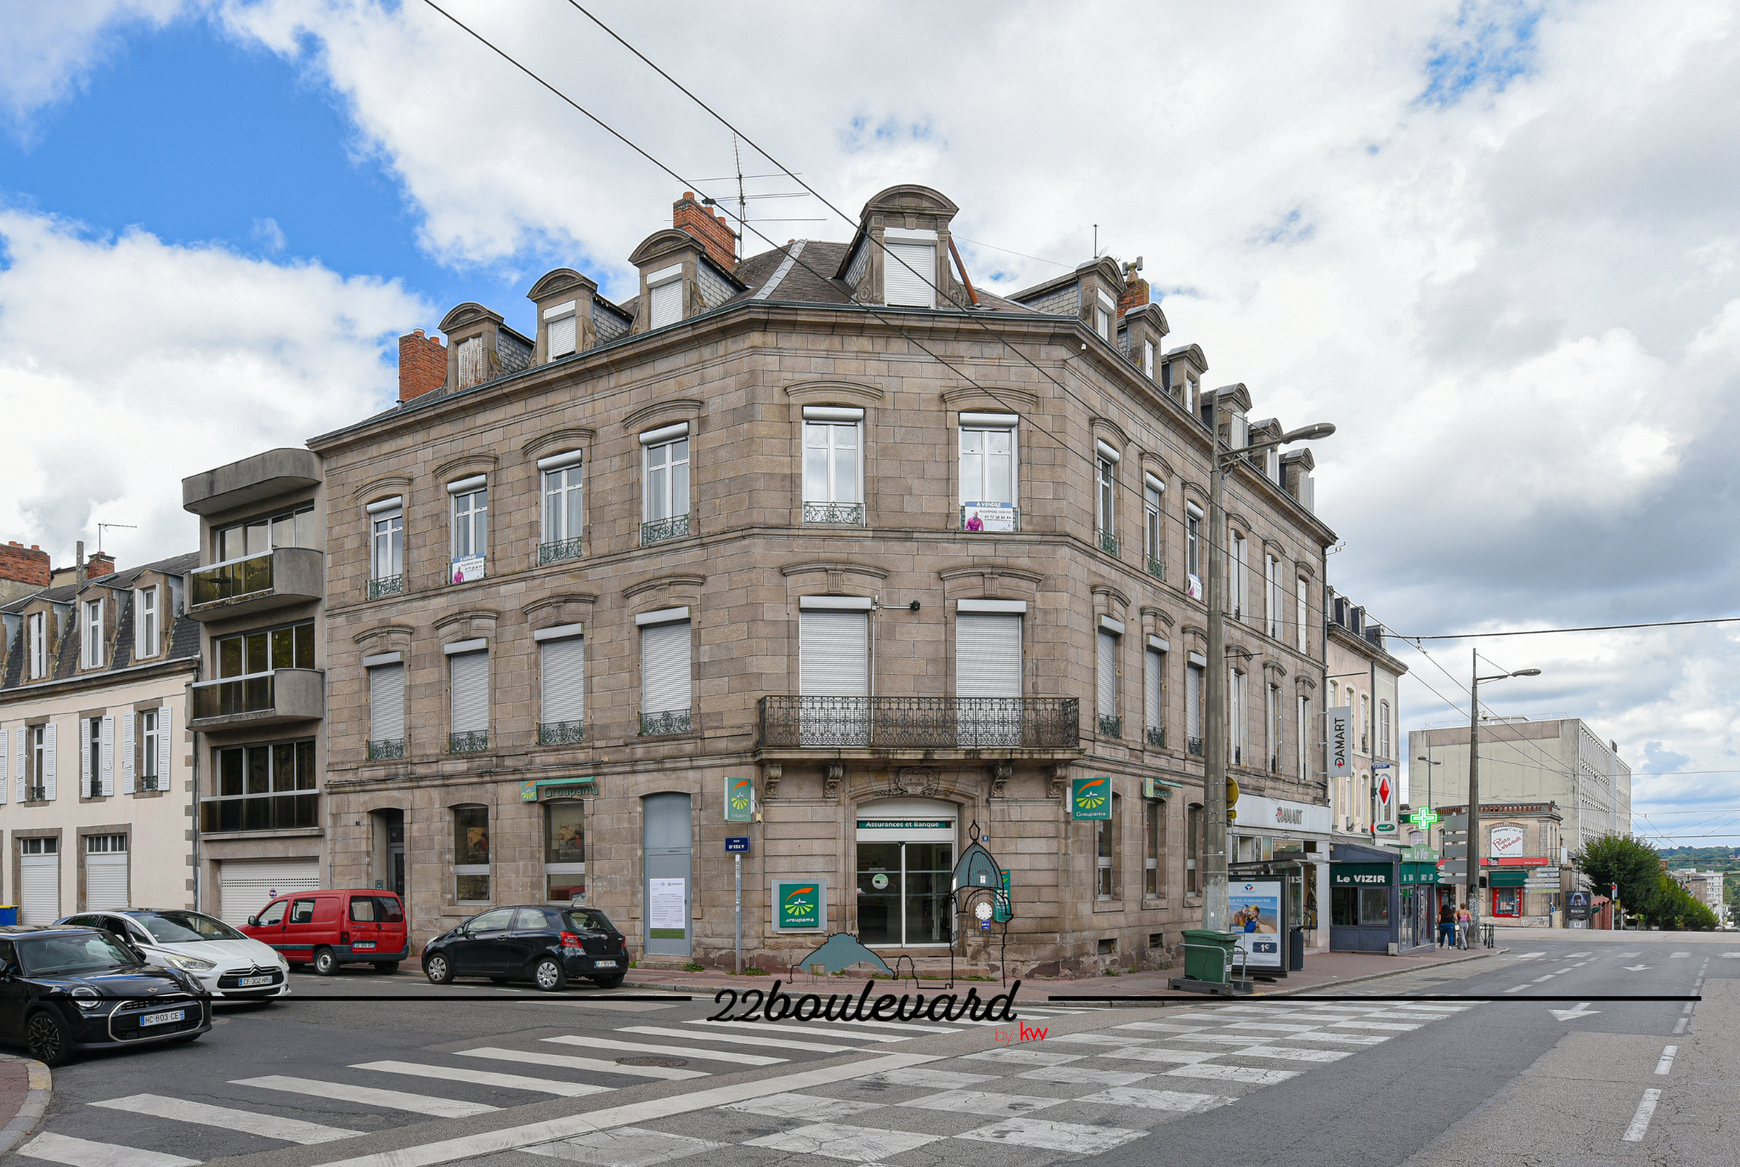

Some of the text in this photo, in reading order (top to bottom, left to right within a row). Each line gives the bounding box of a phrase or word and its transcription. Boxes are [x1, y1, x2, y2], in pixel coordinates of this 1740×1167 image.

[1334, 717, 1345, 769] DAMART
[543, 787, 599, 798] Groupama
[914, 821, 940, 829] Banque
[1336, 874, 1386, 883] Le VIZIR
